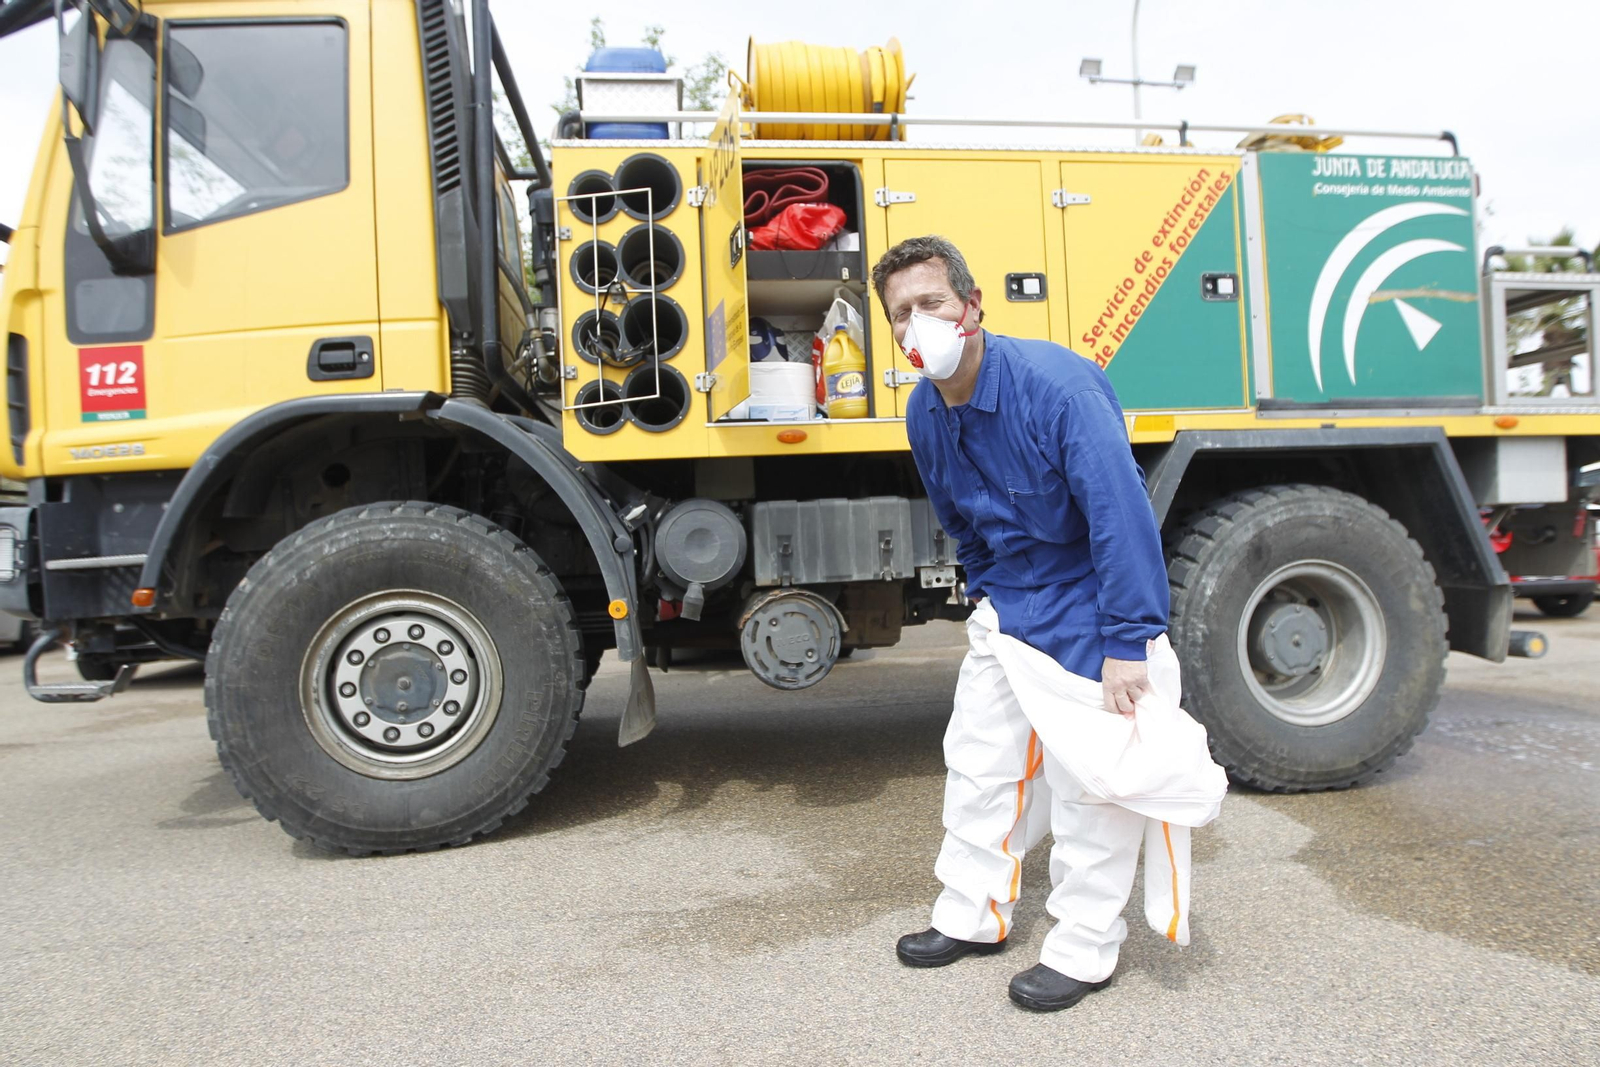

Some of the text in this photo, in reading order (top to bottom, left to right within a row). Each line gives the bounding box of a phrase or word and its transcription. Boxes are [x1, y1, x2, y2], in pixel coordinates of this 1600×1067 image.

[1312, 156, 1361, 177] JUNTA
[1366, 158, 1386, 178] DE
[1313, 182, 1471, 198] Consejería de Medio Ambiente
[1082, 167, 1211, 348] Servicio de extinción
[1095, 170, 1231, 370] de incendios forestales
[85, 361, 138, 386] 112
